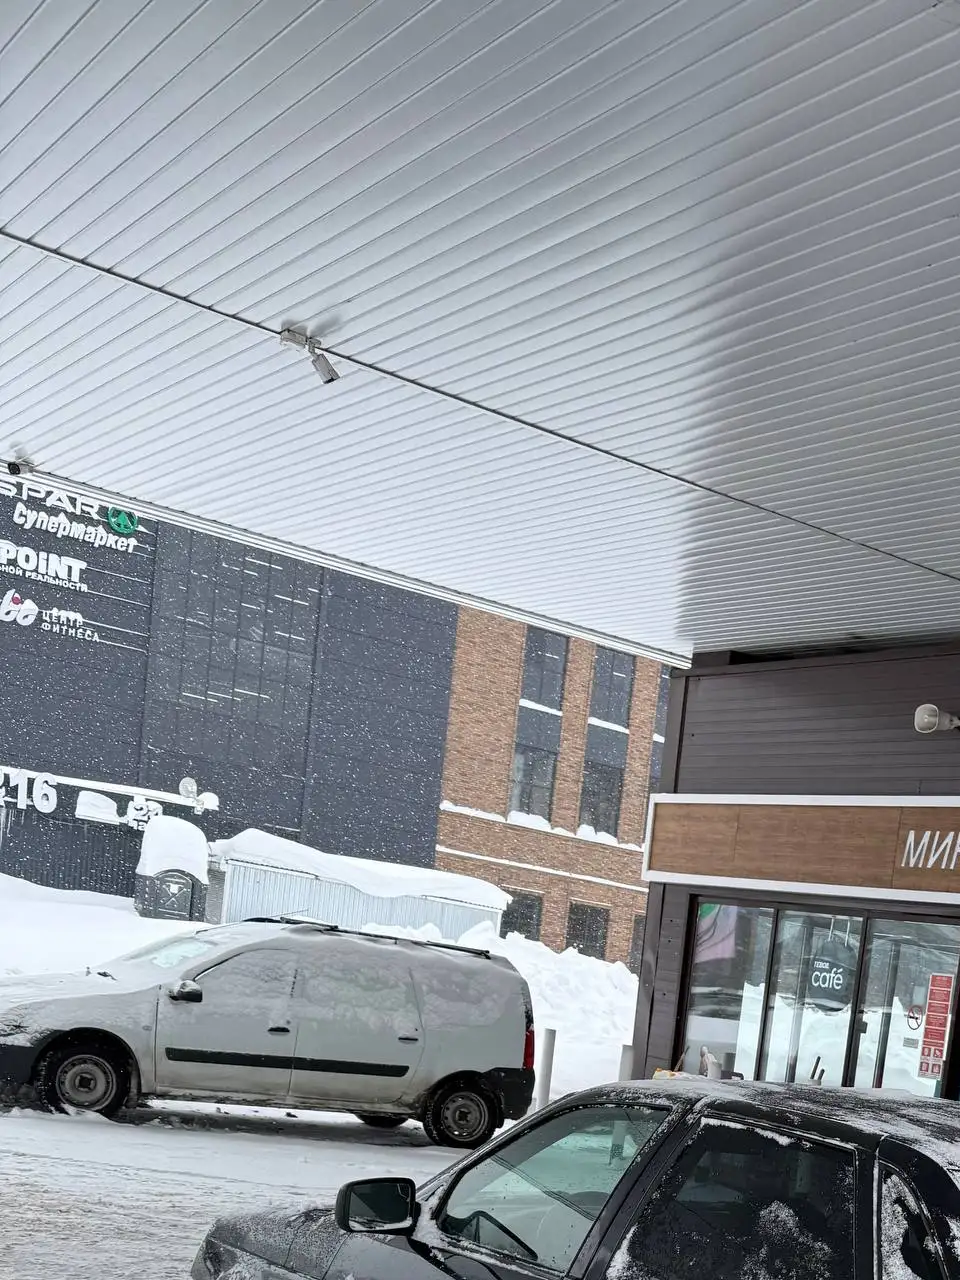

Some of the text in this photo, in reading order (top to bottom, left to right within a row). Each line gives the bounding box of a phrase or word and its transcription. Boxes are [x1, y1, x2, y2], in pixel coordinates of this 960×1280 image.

[13, 501, 138, 553] Супермаркет
[0, 564, 23, 577] НОЙ
[42, 609, 84, 628] ЦЕНТР
[41, 623, 99, 642] ФИТНЕСА
[811, 968, 844, 990] café
